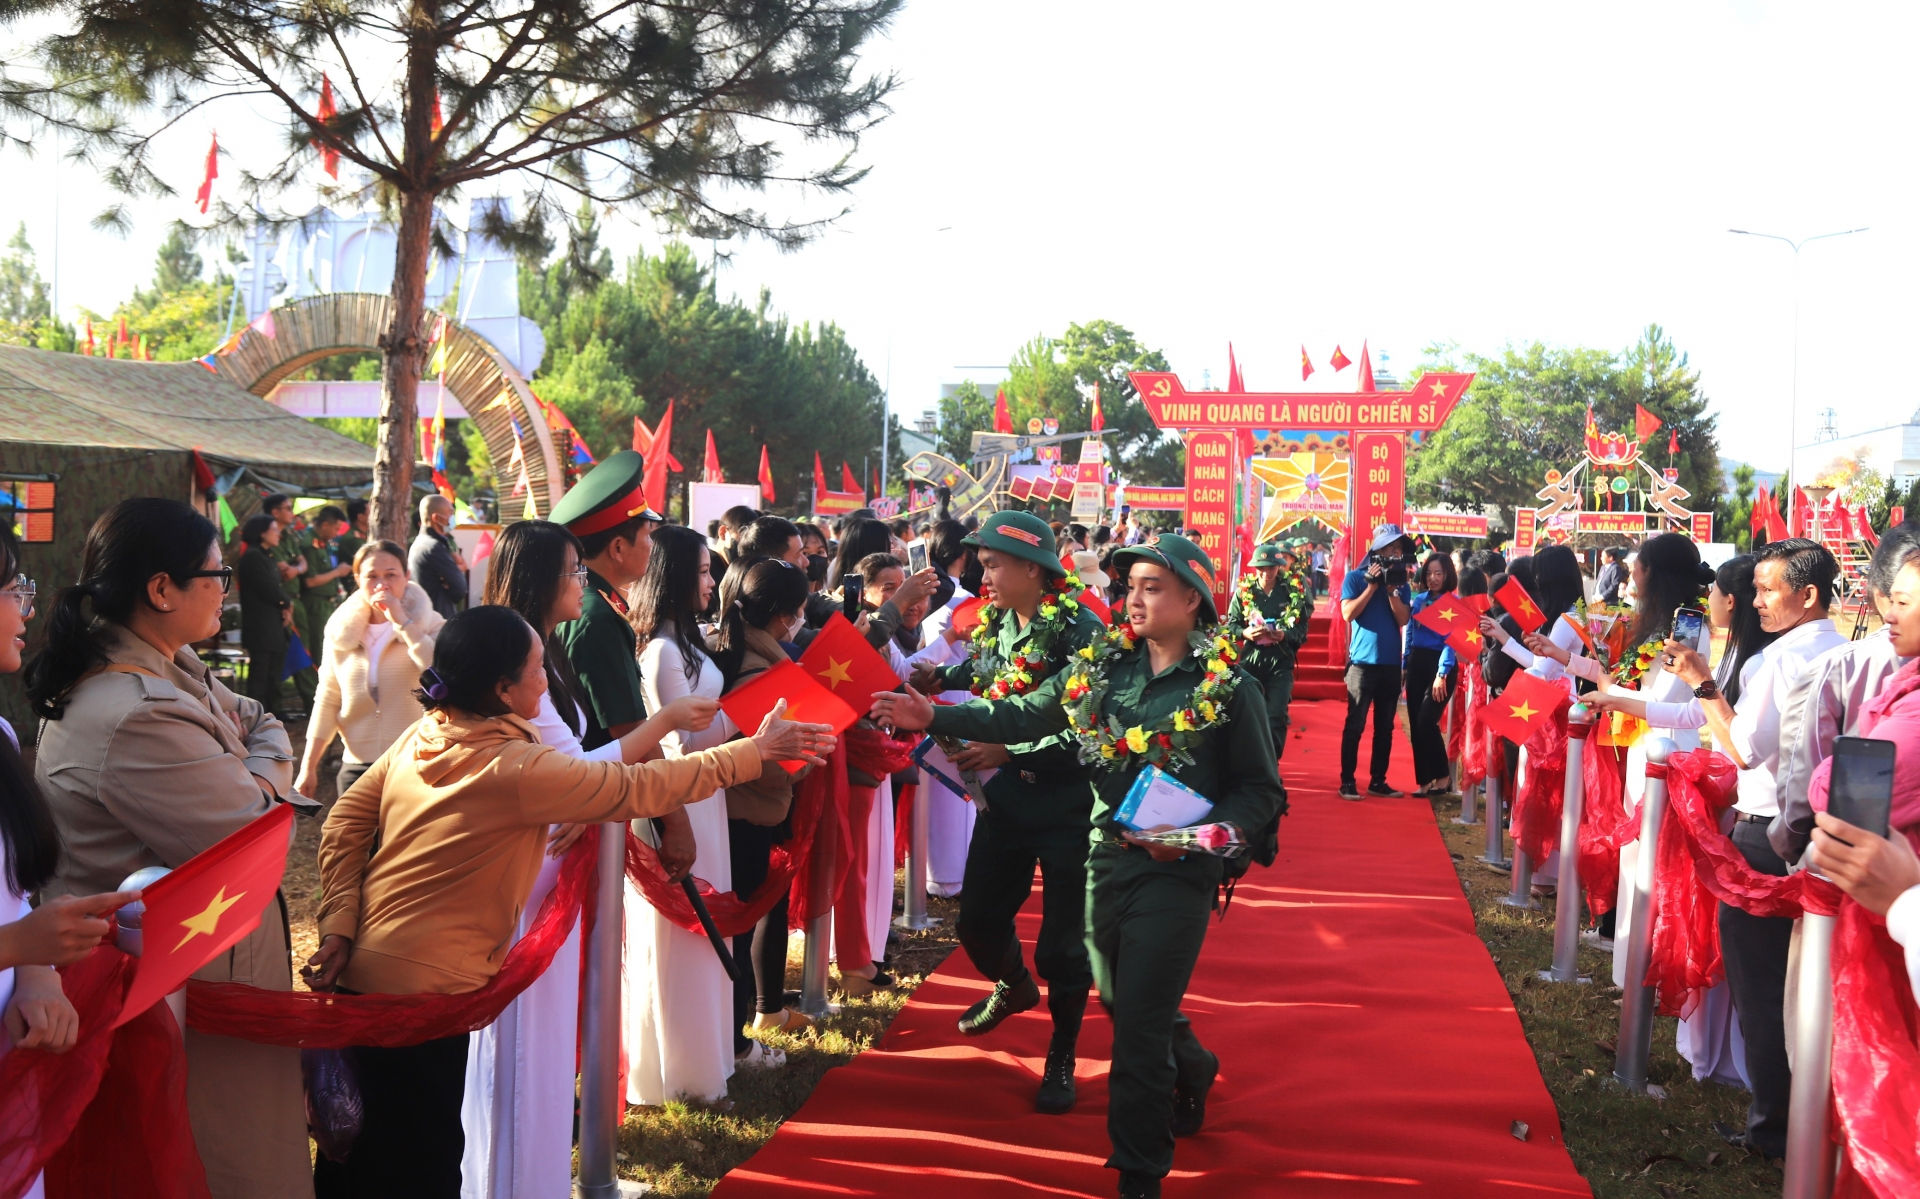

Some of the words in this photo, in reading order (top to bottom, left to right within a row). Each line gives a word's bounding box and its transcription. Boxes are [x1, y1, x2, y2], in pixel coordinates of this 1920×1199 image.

[1161, 403, 1201, 422] VINH
[1207, 403, 1265, 423] QUANG
[1271, 400, 1291, 423] LÀ
[1297, 401, 1351, 423] NGƯỜI
[1357, 397, 1412, 423] CHIẾN
[1417, 400, 1436, 423] SĨ
[1195, 440, 1226, 458] QUÂN
[1372, 442, 1388, 462] BỘ
[1194, 463, 1225, 480] NHÂN
[1369, 466, 1390, 486] ĐỘI
[1193, 485, 1225, 503] CÁCH
[1371, 492, 1388, 509] CỤ
[1192, 511, 1225, 528] MẠNG
